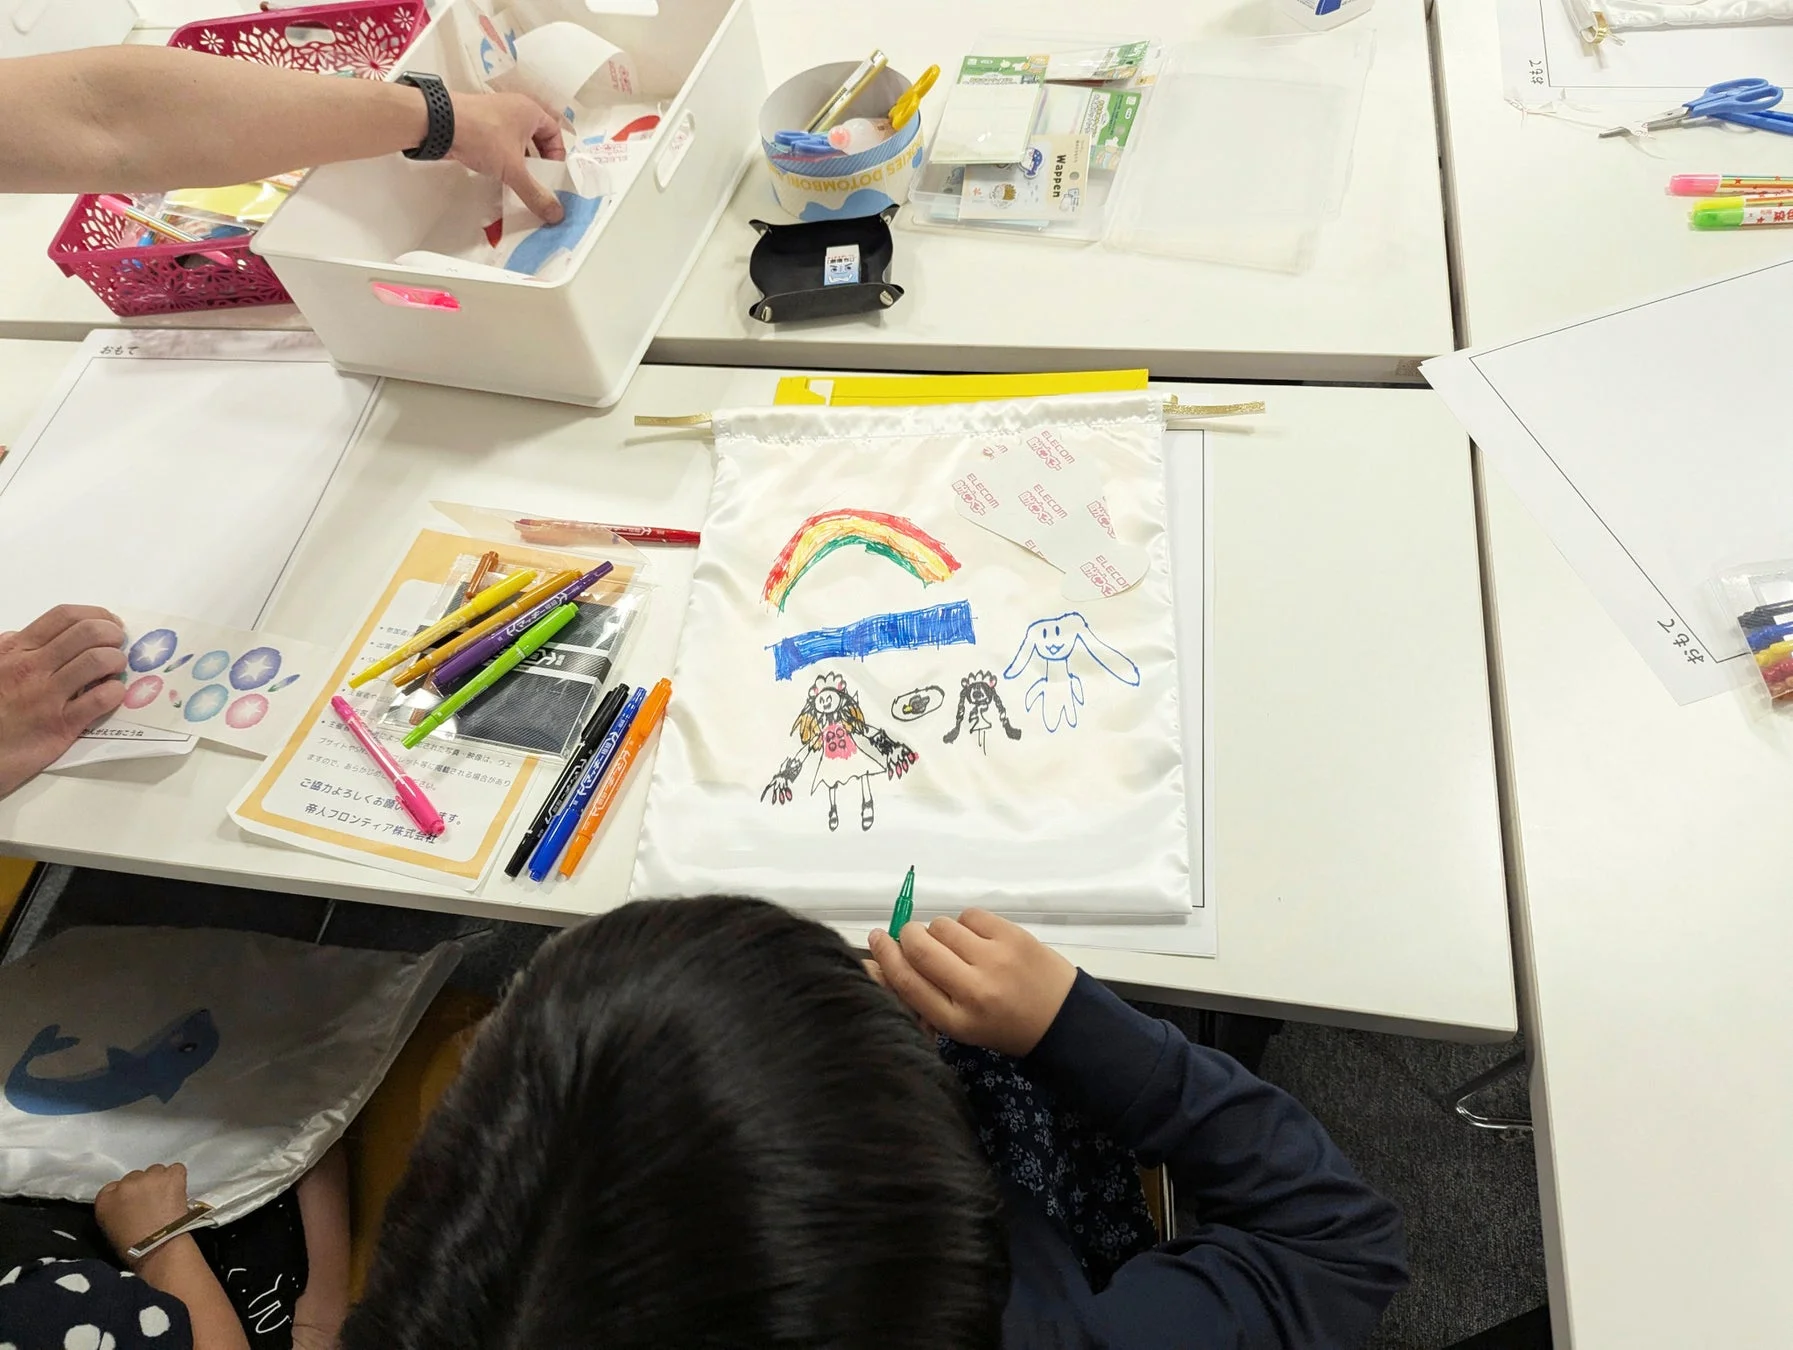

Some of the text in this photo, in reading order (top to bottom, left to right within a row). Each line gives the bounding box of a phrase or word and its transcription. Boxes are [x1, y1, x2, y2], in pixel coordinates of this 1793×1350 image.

[1529, 59, 1543, 86] おもて
[1053, 154, 1067, 198] Wappen
[100, 345, 140, 355] おもて
[1041, 430, 1075, 464] ELECOM
[967, 473, 1000, 508] ELECOM
[1033, 483, 1068, 518] ELECOM
[1657, 618, 1705, 664] おもて
